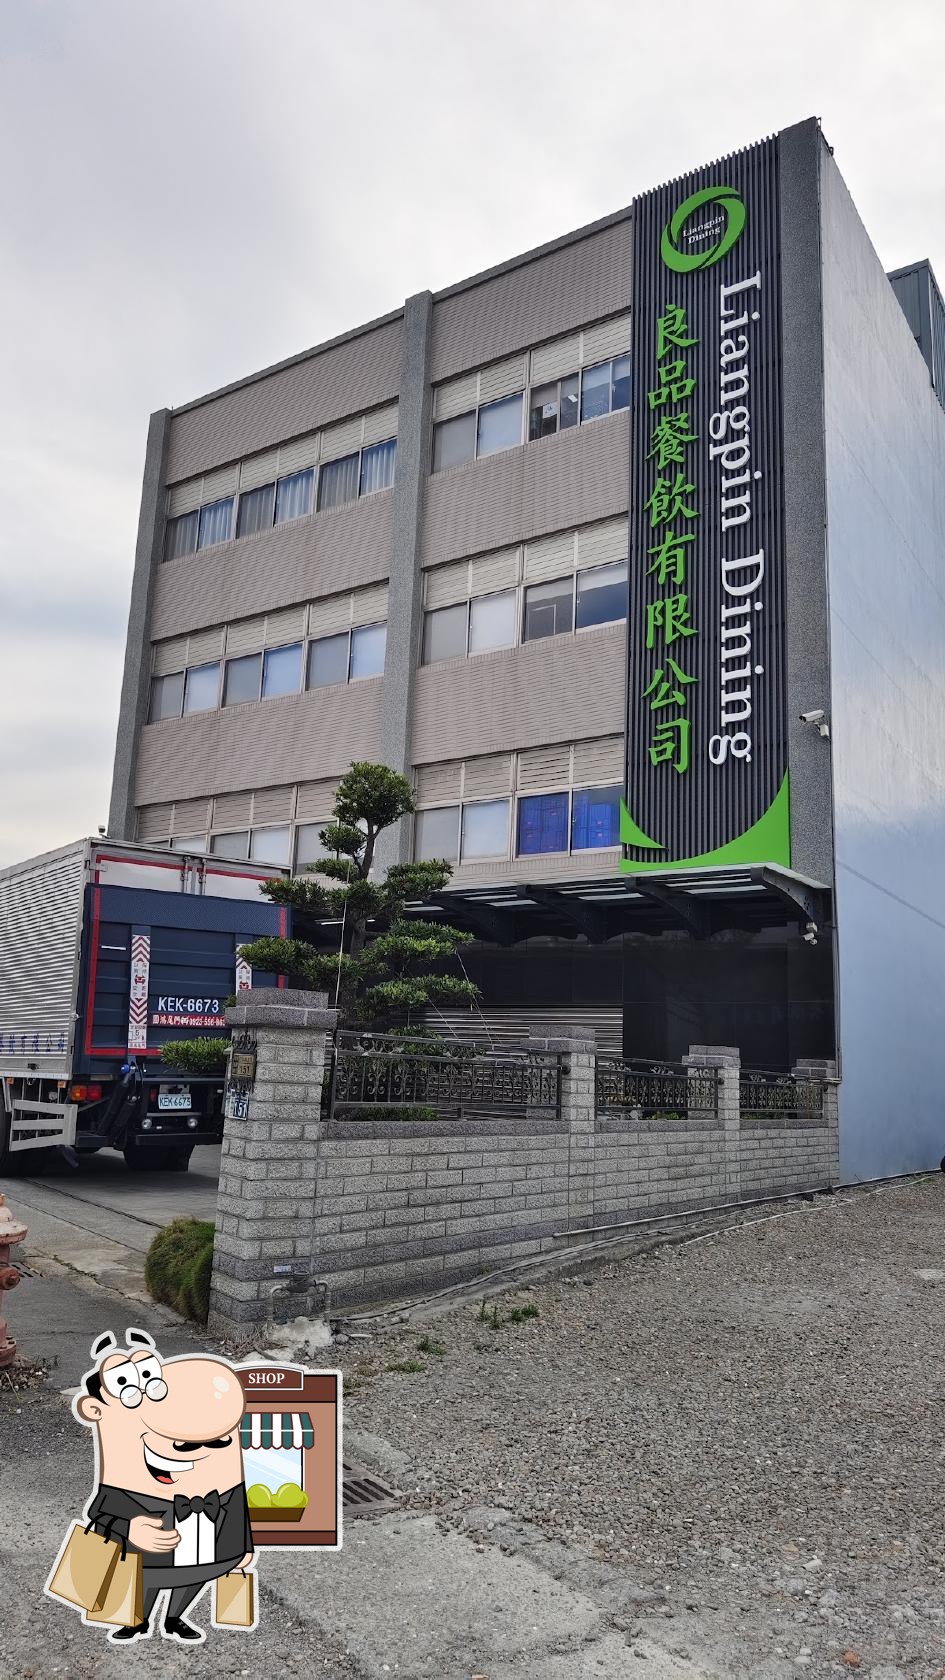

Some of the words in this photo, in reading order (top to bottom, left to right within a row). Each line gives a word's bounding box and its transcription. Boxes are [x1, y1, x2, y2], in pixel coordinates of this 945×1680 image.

[683, 215, 725, 238] Liangpin
[688, 226, 721, 244] Dining
[709, 270, 763, 532] Liangpin
[641, 304, 700, 774] 良品餐飲有限公司
[708, 549, 765, 765] Dining
[157, 997, 219, 1013] KEK-6673
[234, 1101, 247, 1118] 151
